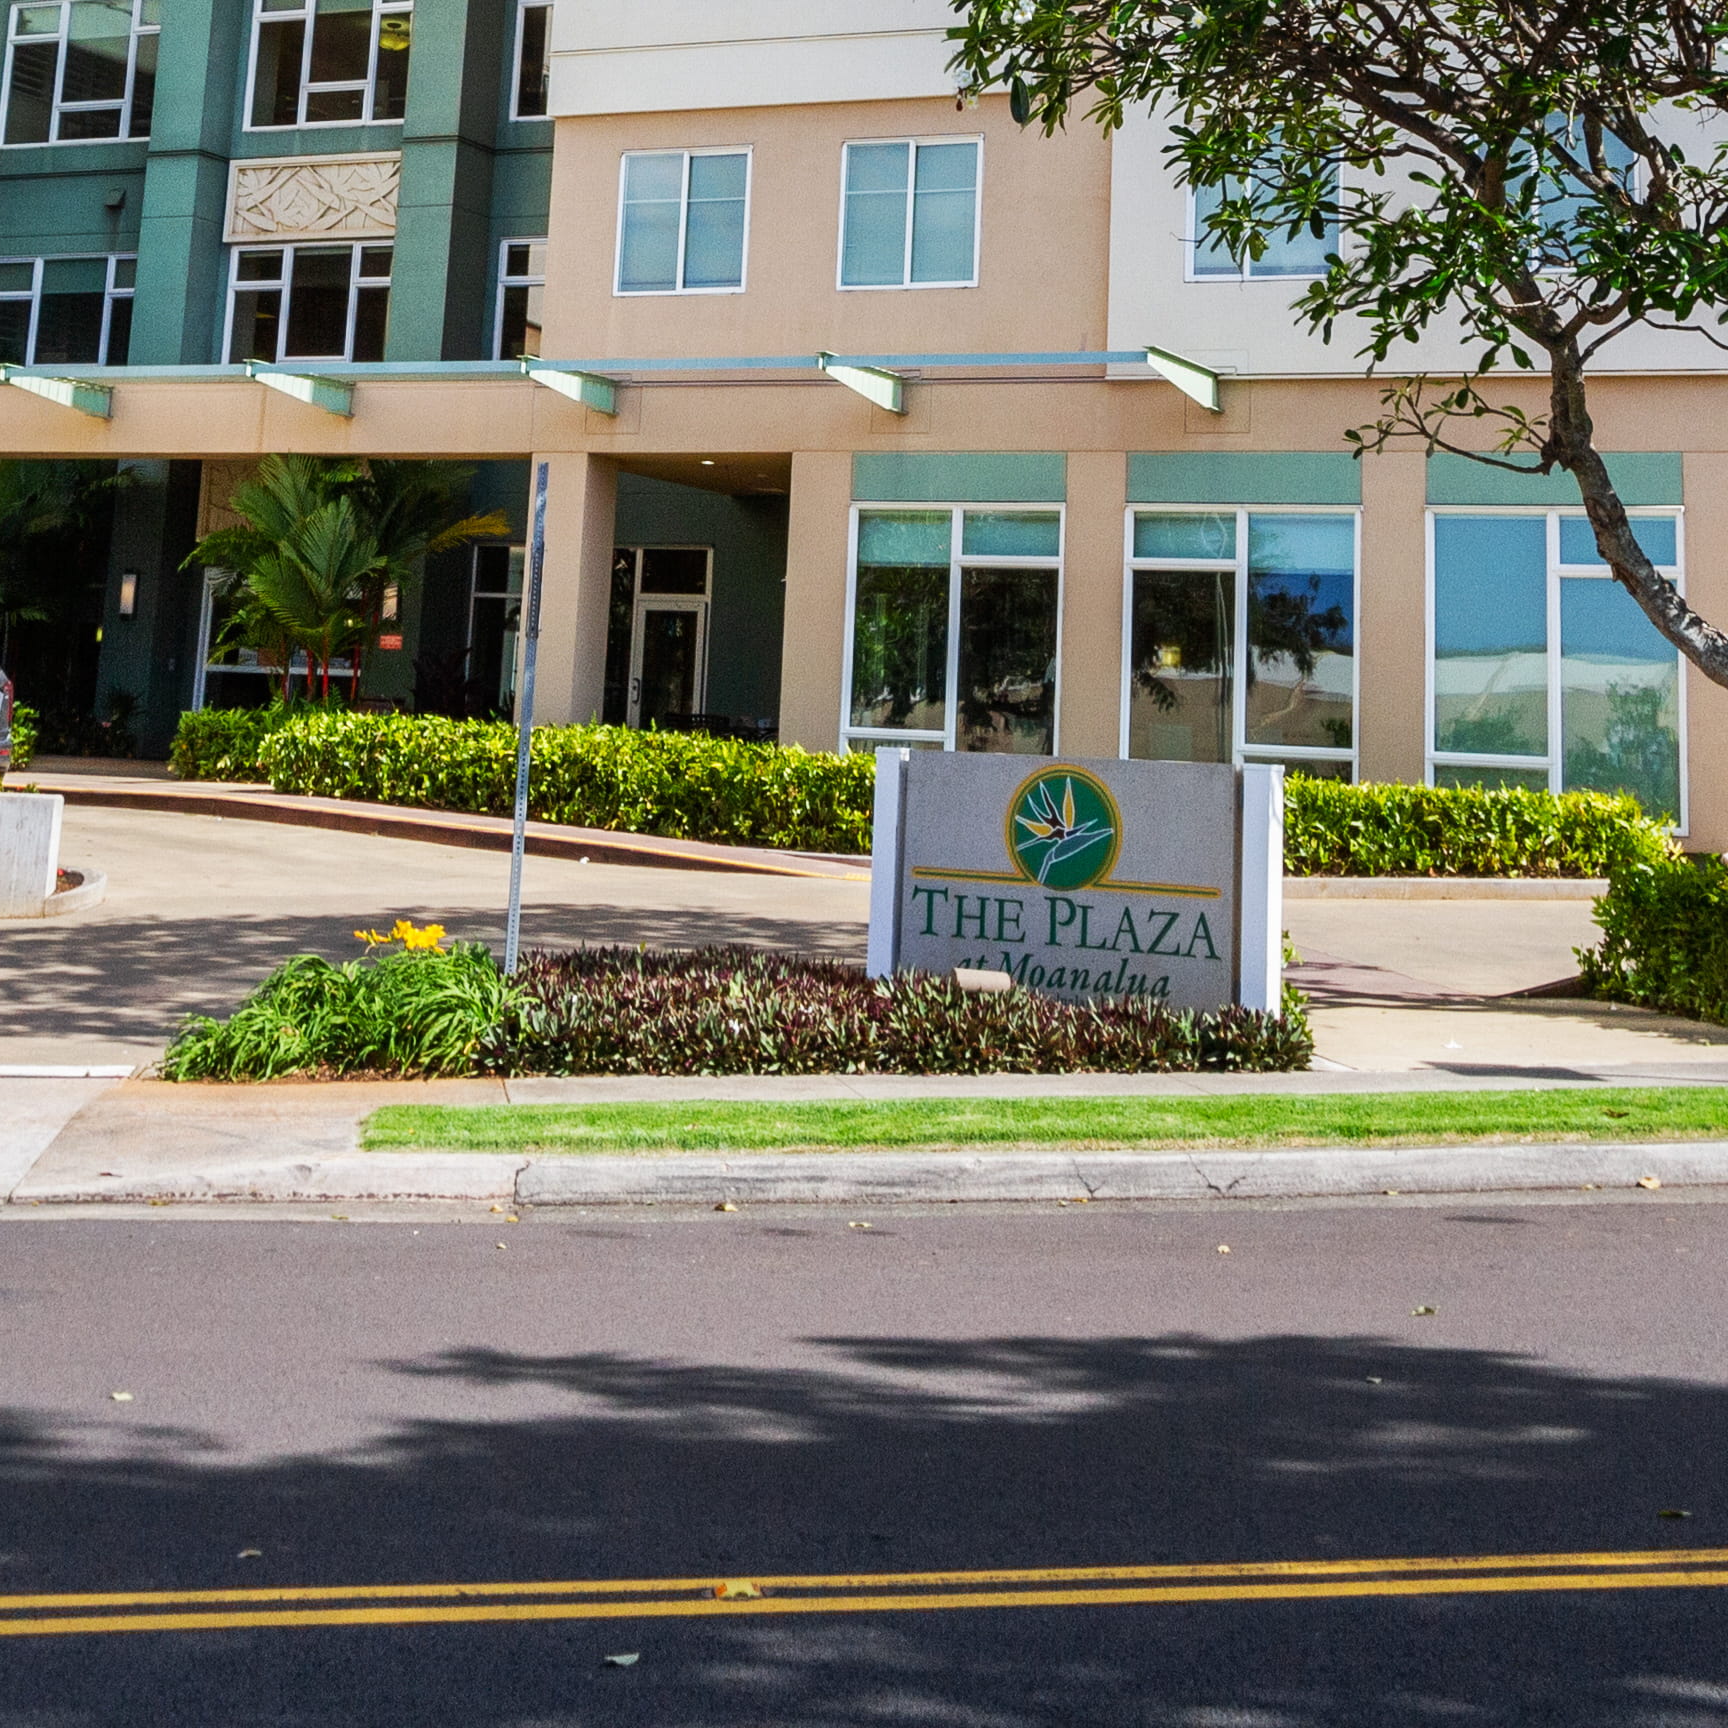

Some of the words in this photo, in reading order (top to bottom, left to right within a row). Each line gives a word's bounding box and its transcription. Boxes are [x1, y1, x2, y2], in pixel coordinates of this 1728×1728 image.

[912, 885, 1026, 943] THE
[1044, 896, 1221, 961] PLAZA
[998, 950, 1171, 998] Moanalua
